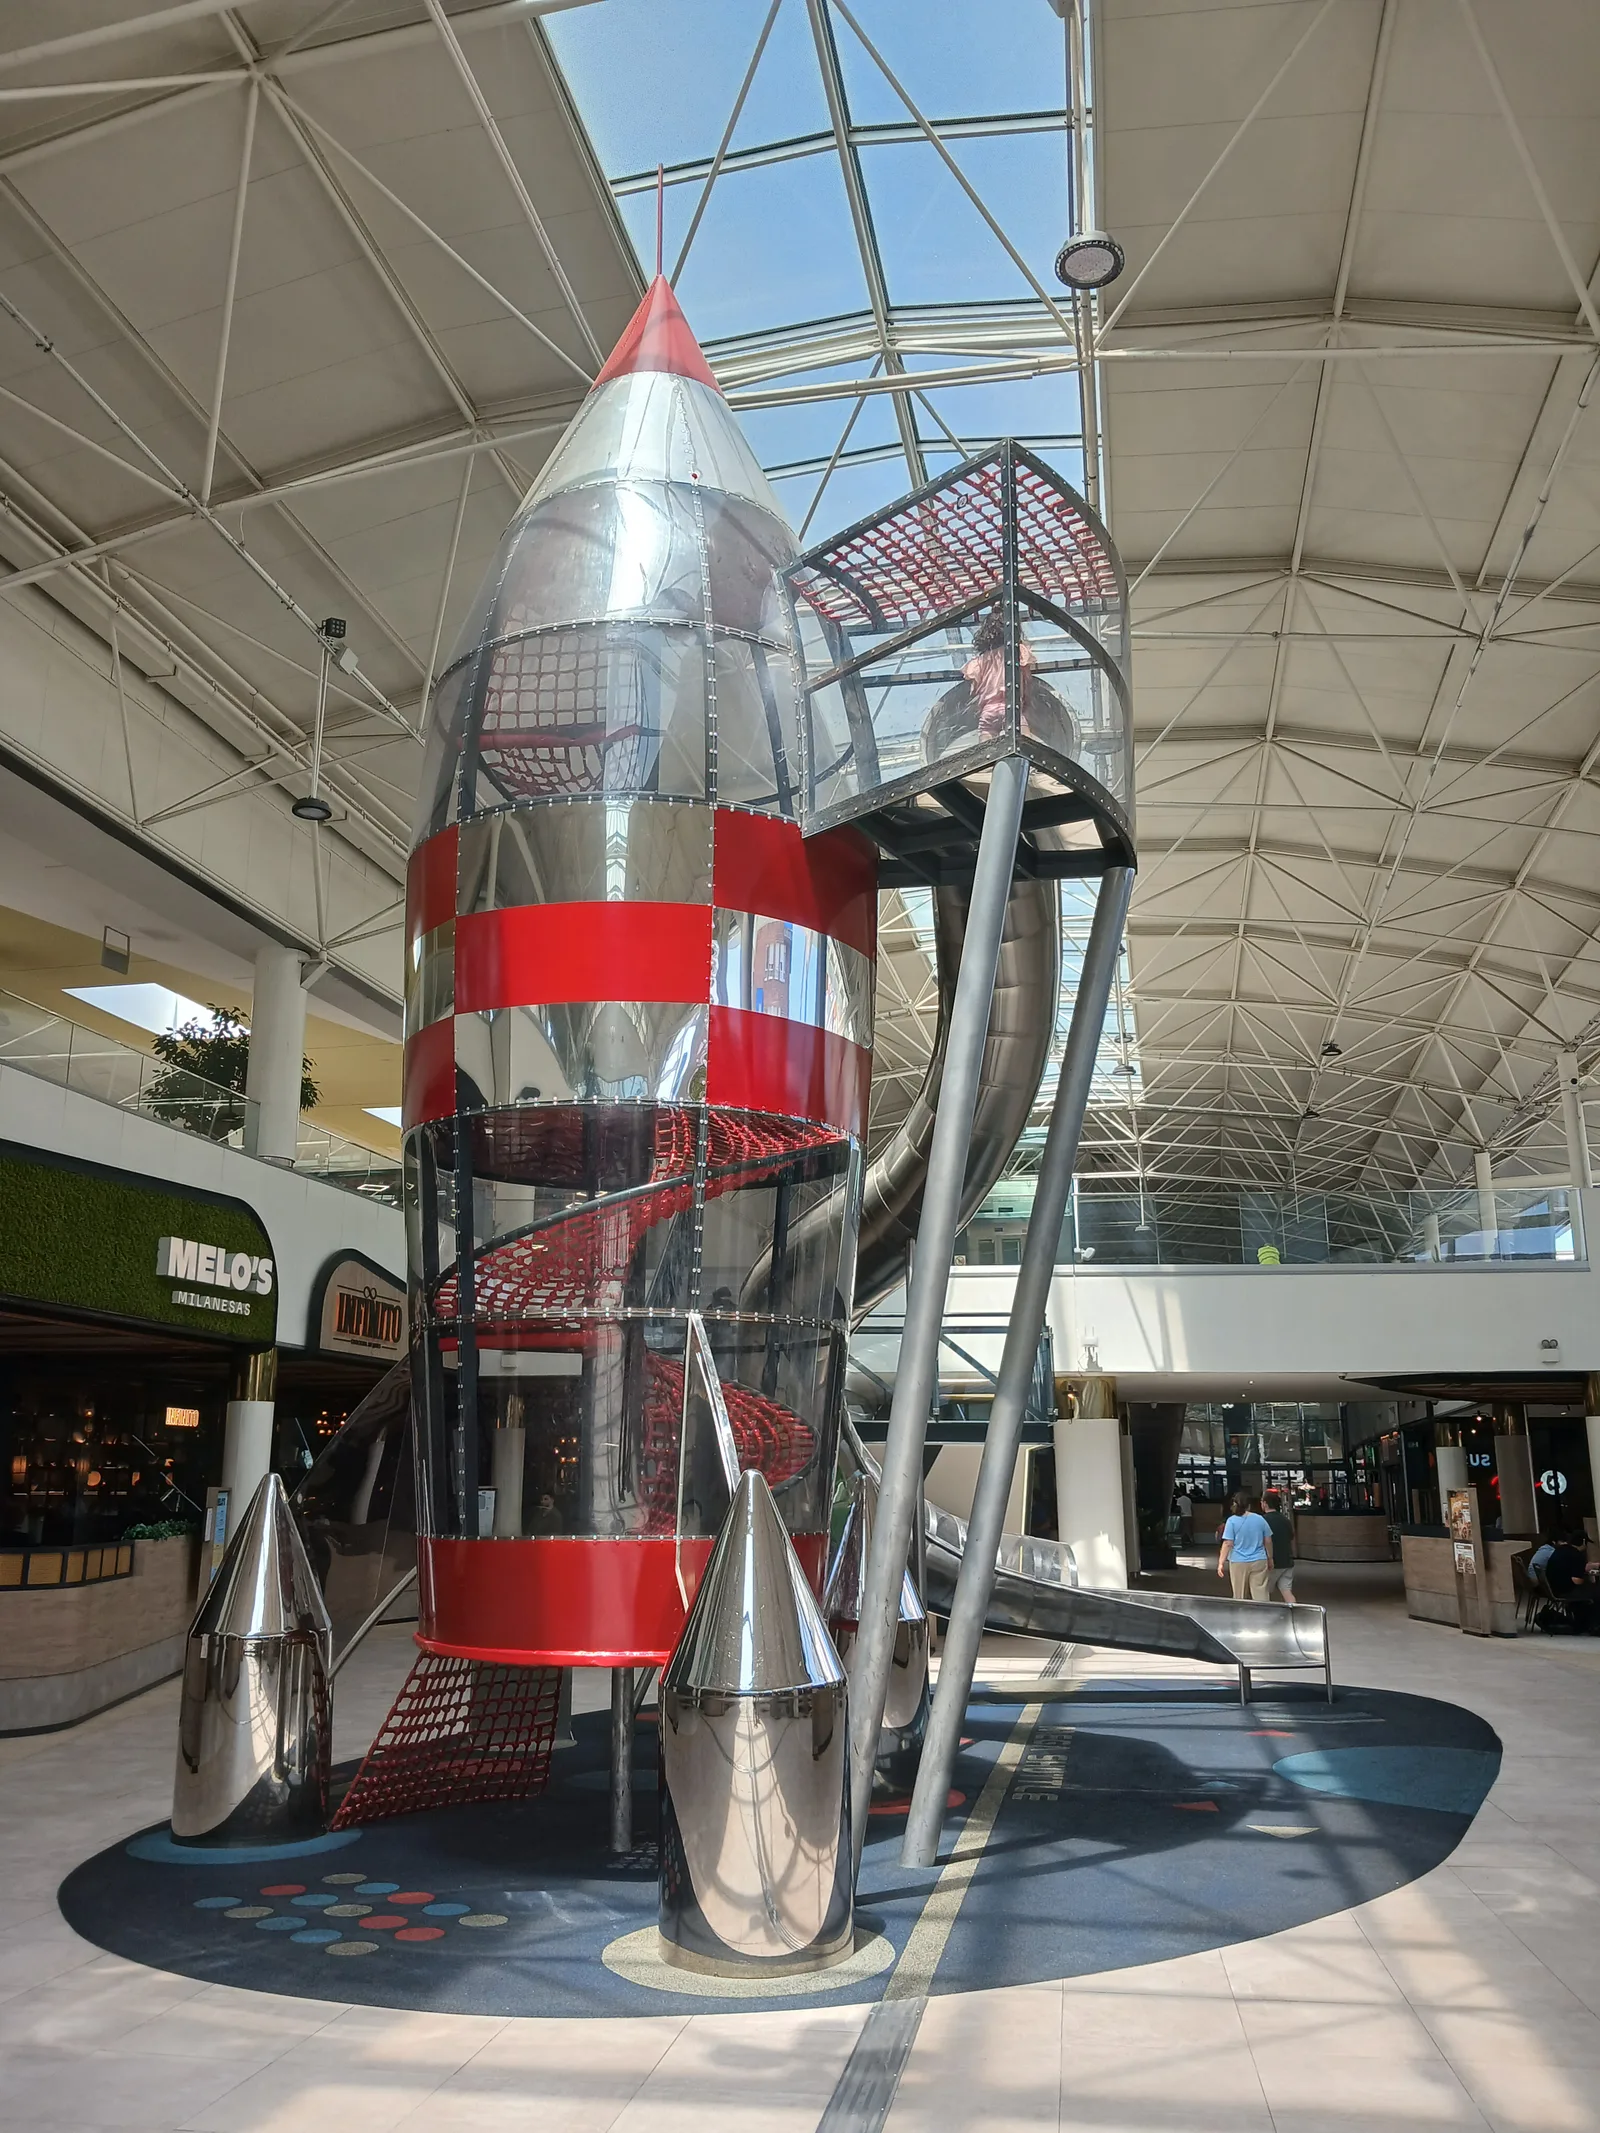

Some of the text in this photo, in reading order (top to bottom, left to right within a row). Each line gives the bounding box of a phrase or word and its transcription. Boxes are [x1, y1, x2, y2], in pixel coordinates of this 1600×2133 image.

[166, 1236, 273, 1295] MELO'S
[177, 1290, 251, 1316] MILANESAS
[335, 1292, 402, 1343] INFINITO
[165, 1406, 199, 1428] INFINITO
[1012, 1755, 1068, 1801] SHUTTLE
